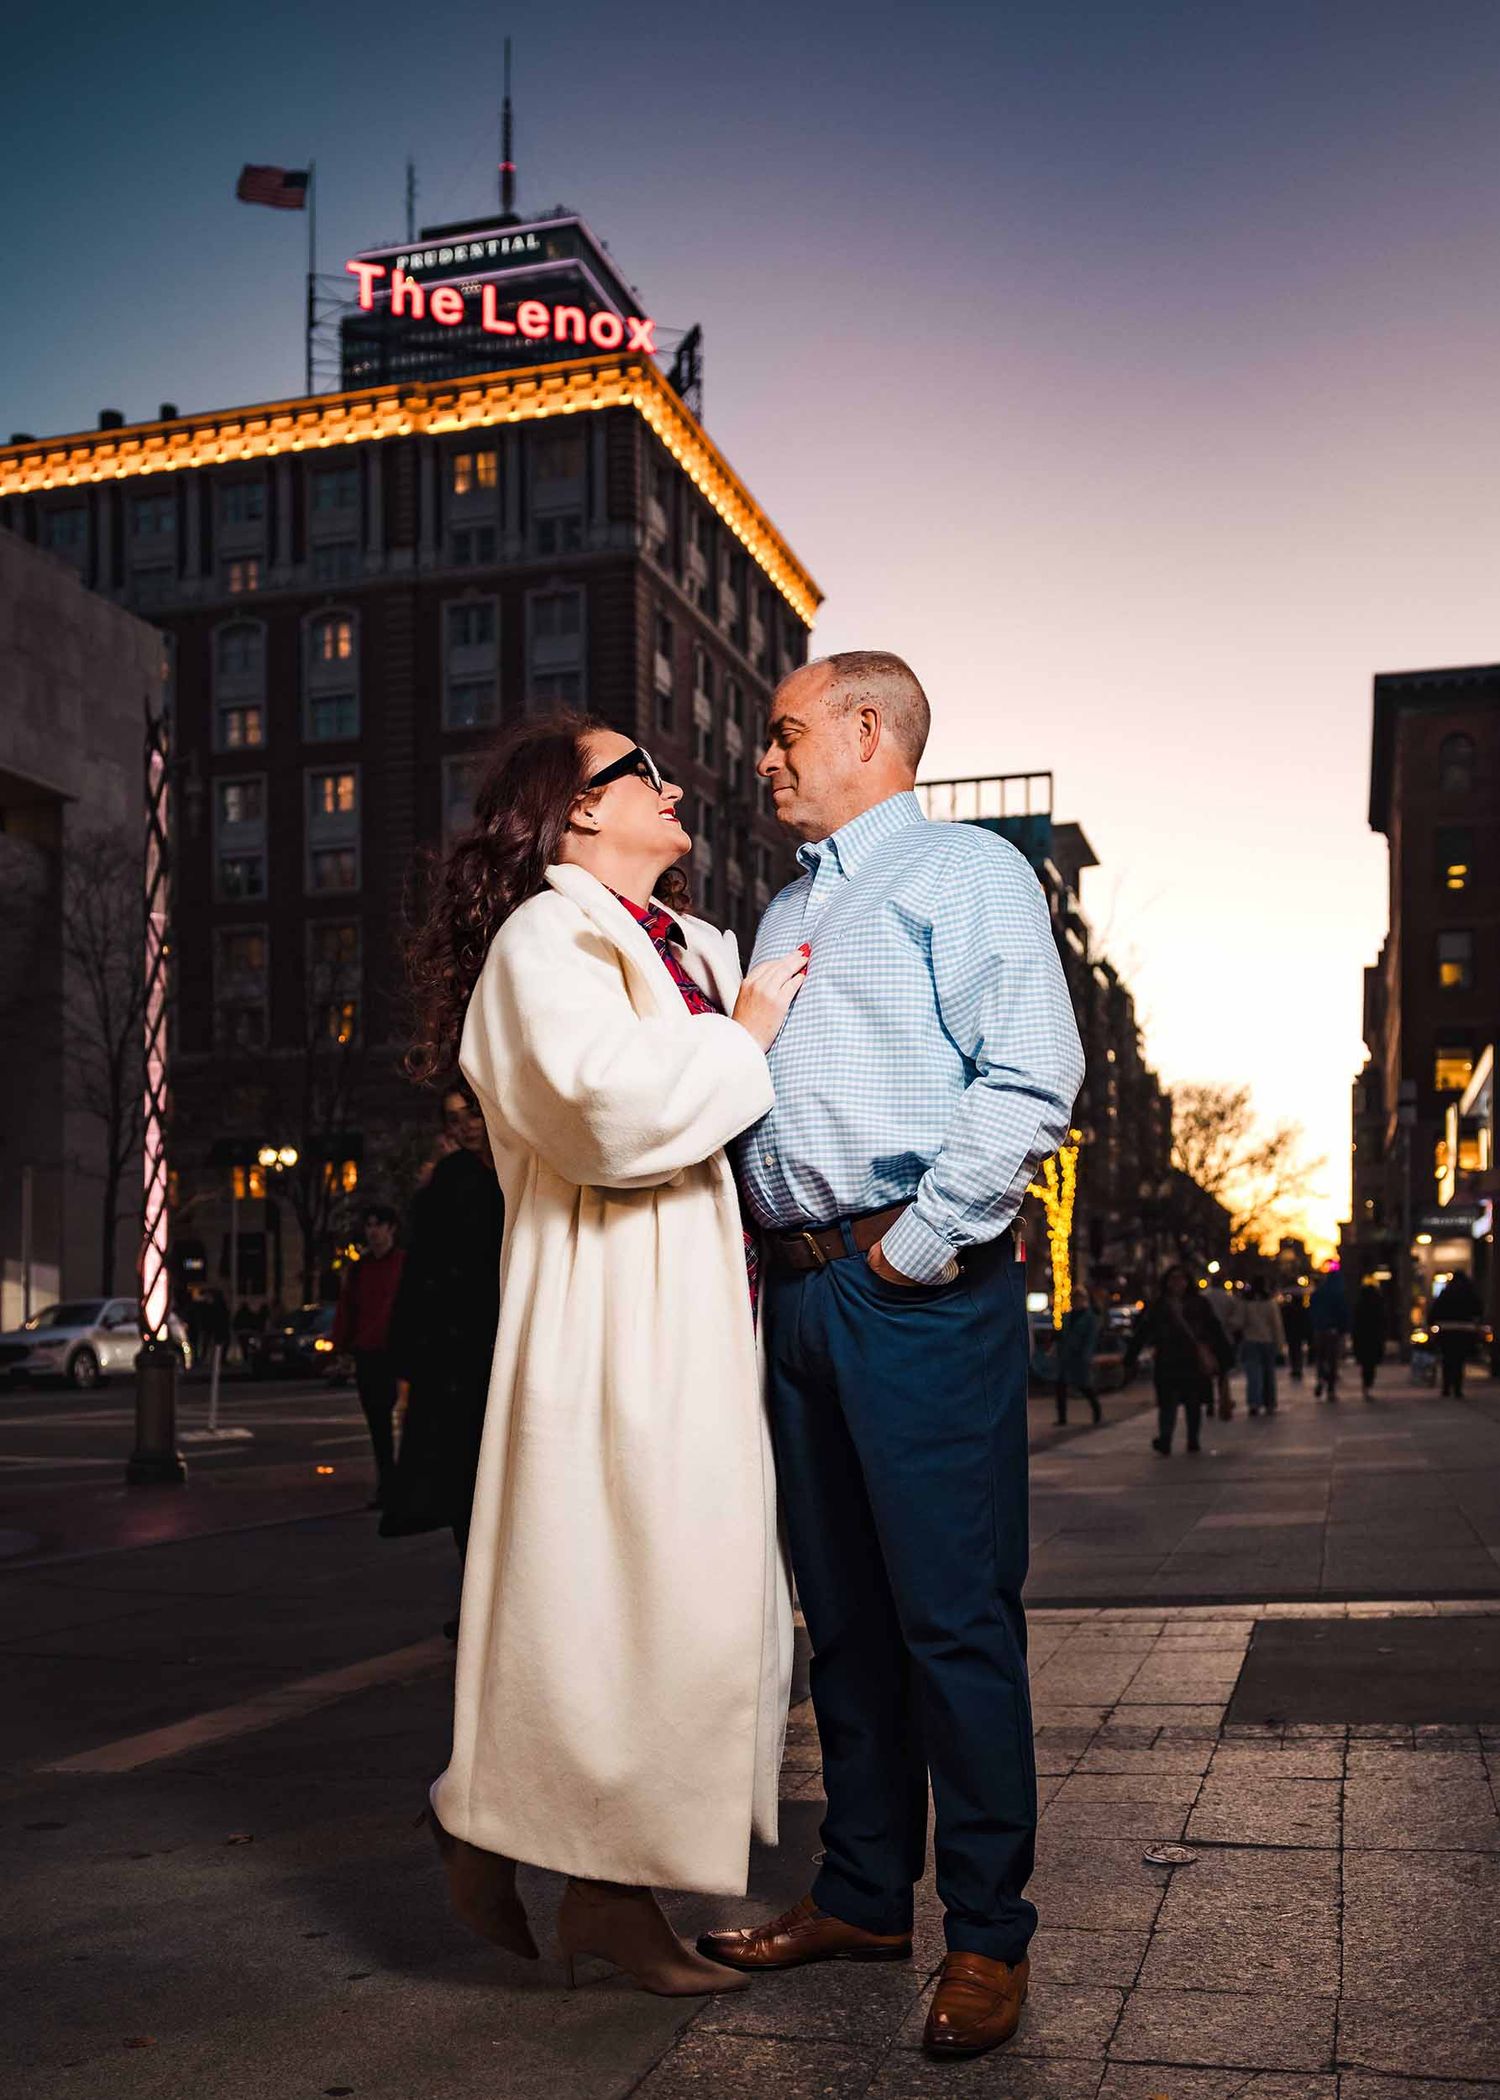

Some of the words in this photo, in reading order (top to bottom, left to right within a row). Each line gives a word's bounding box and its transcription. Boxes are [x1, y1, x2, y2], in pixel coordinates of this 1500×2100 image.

[396, 233, 540, 270] PRUDENTIAL
[346, 260, 465, 325] The
[481, 284, 656, 354] Lenox
